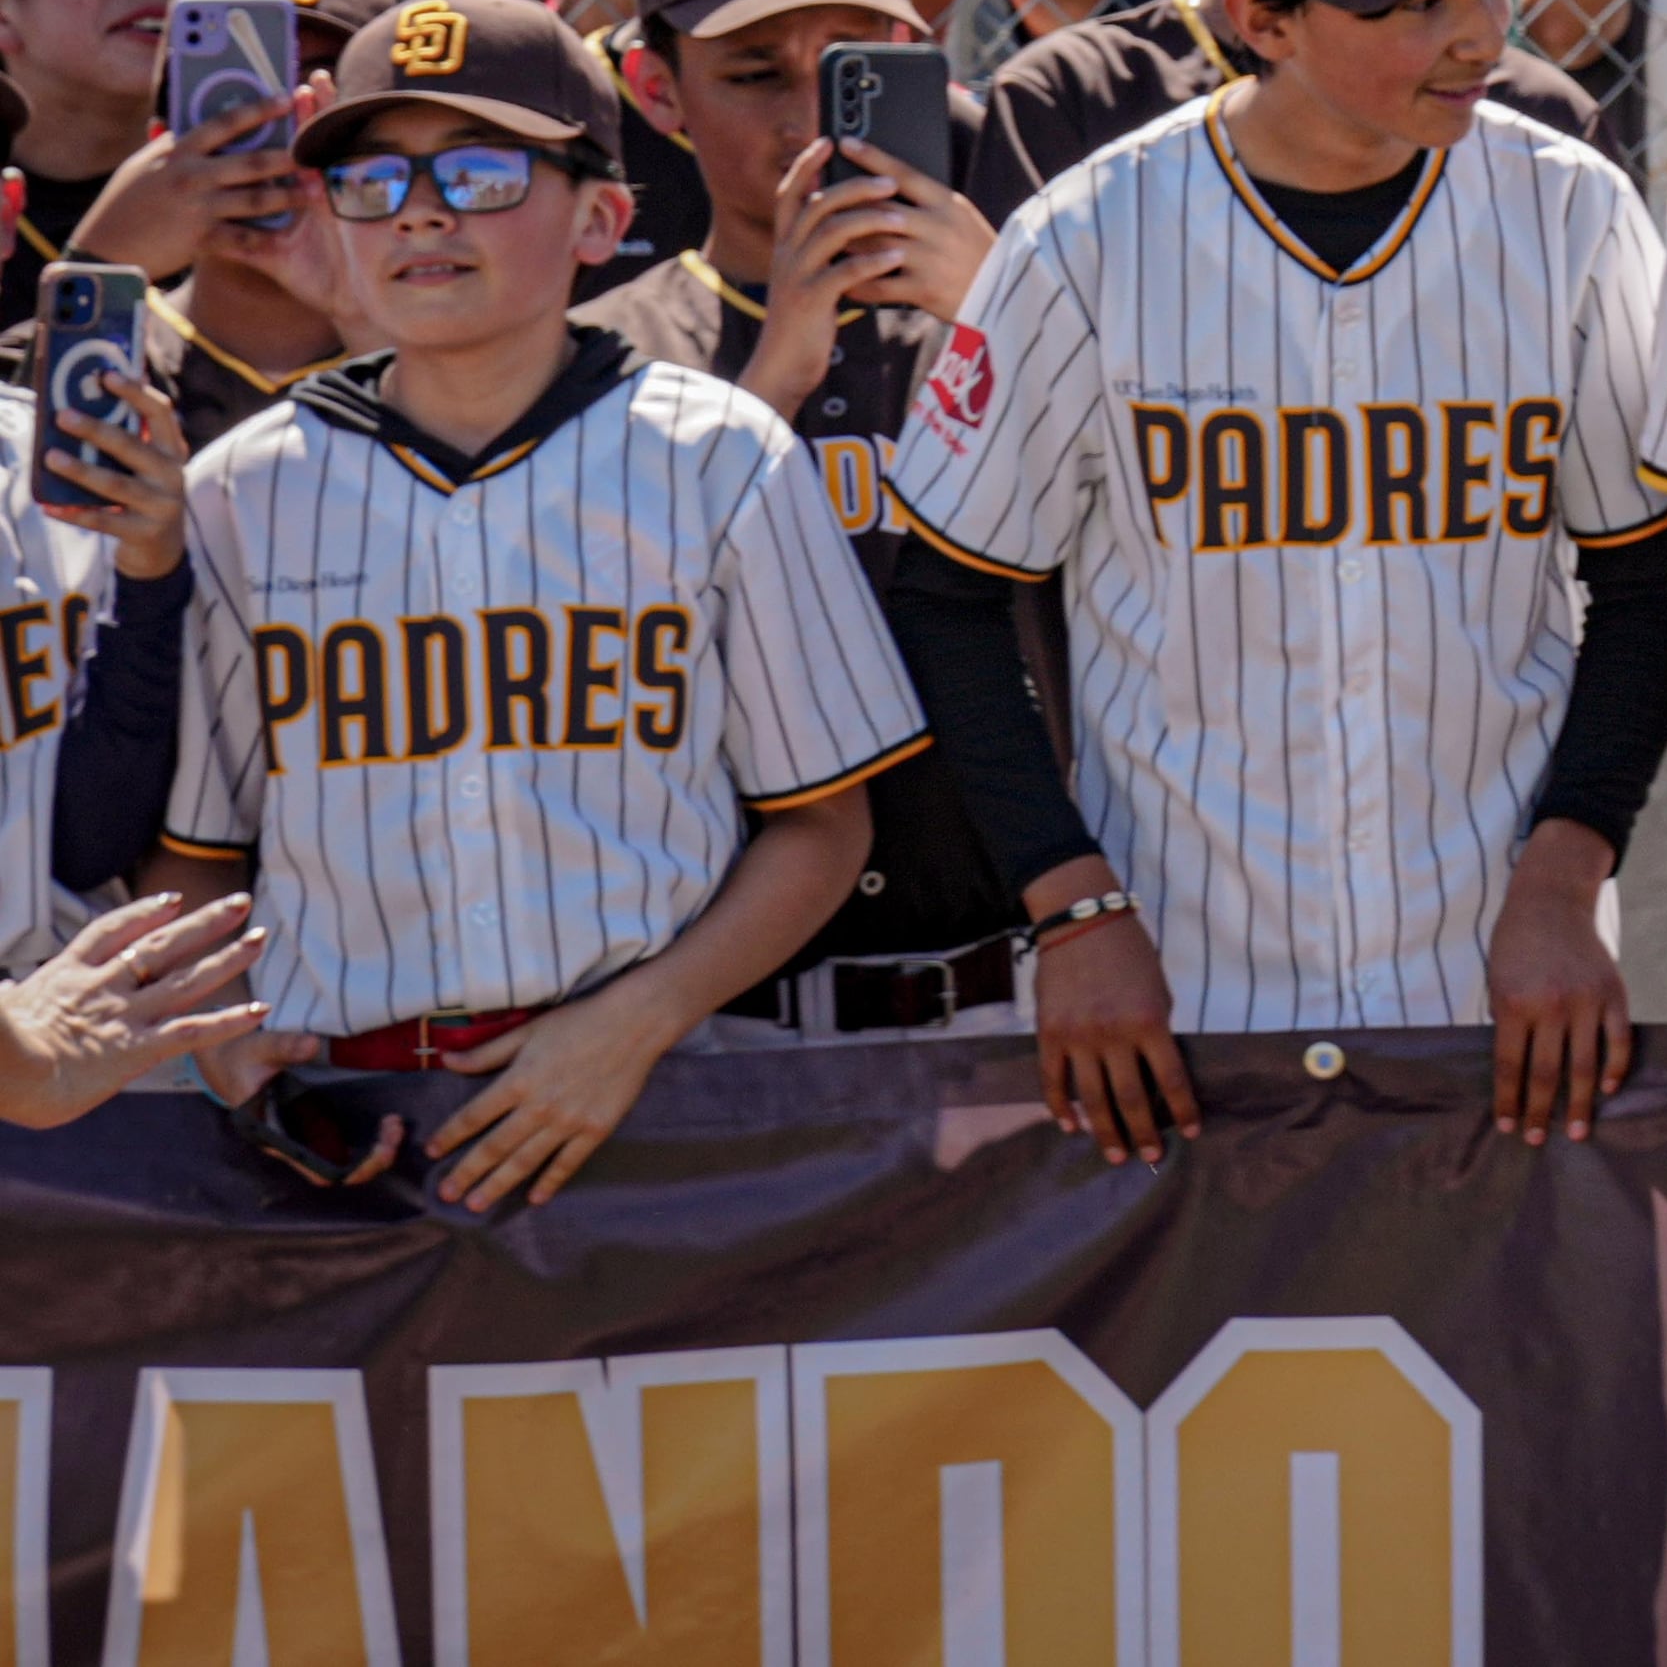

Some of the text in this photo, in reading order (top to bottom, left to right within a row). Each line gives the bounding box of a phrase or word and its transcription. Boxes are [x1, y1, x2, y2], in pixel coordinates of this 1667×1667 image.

[391, 0, 468, 77] SD
[1130, 397, 1563, 552] PADRES
[252, 603, 692, 776] PADRES
[0, 1317, 1483, 1667] ANDO
